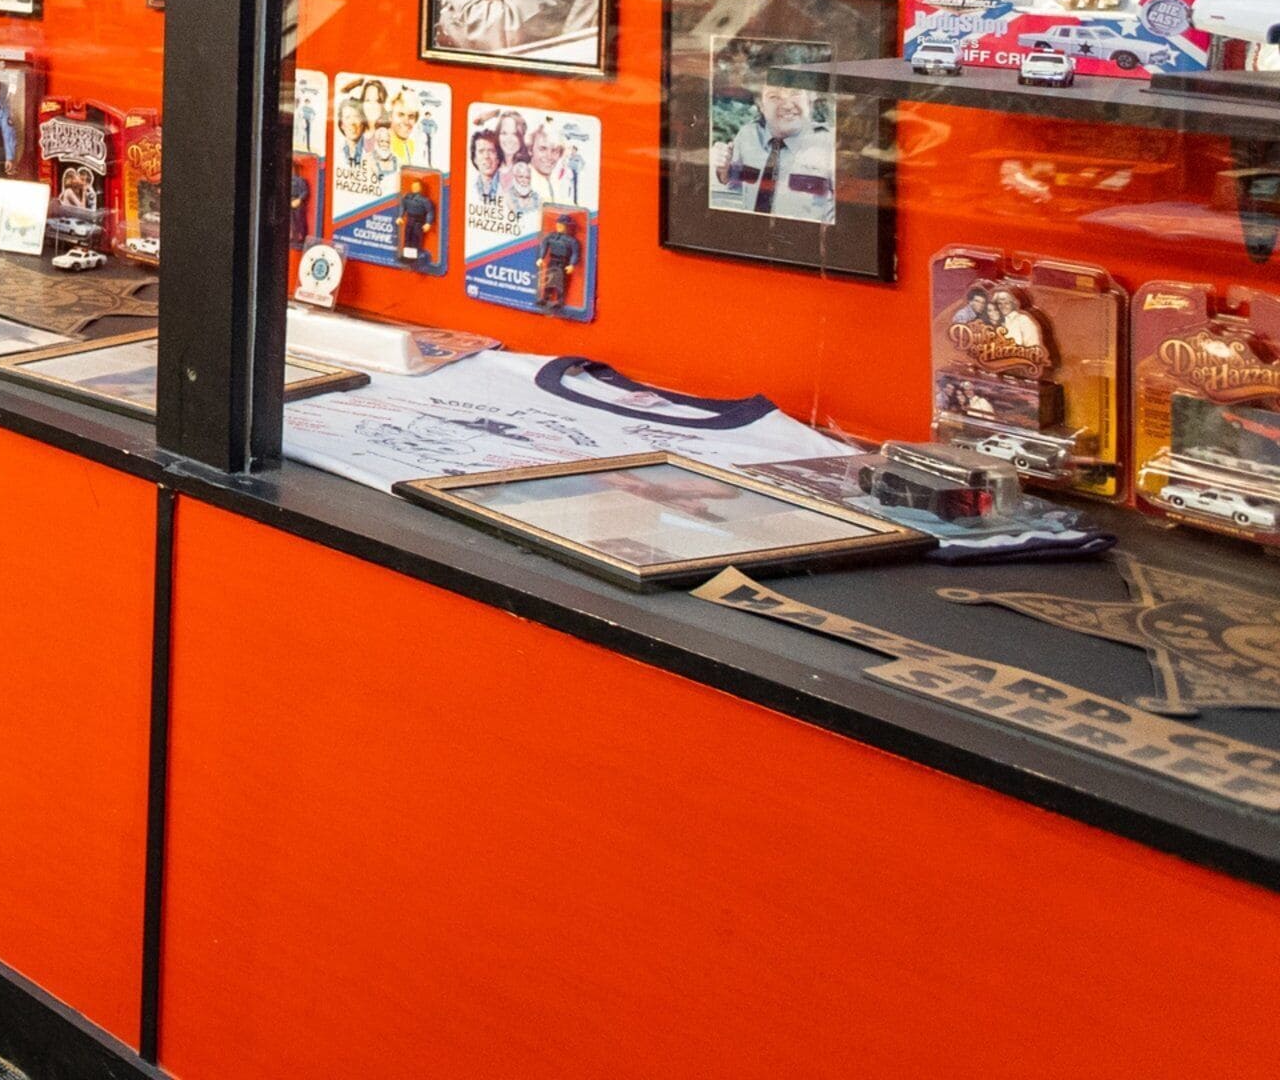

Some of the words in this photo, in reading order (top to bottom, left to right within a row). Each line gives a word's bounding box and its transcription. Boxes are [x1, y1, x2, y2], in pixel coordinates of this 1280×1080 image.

[1158, 2, 1180, 16] DIE
[1148, 11, 1181, 27] CAST
[348, 158, 367, 168] THE
[336, 168, 368, 182] DUKES
[371, 174, 384, 184] OF
[336, 181, 383, 196] HAZZARD
[482, 193, 504, 207] THE
[468, 203, 505, 220] DUKES
[508, 210, 523, 222] OF
[468, 217, 521, 236] HAZZARD
[485, 264, 532, 286] CLETUS
[720, 583, 1133, 724] HAZZARD
